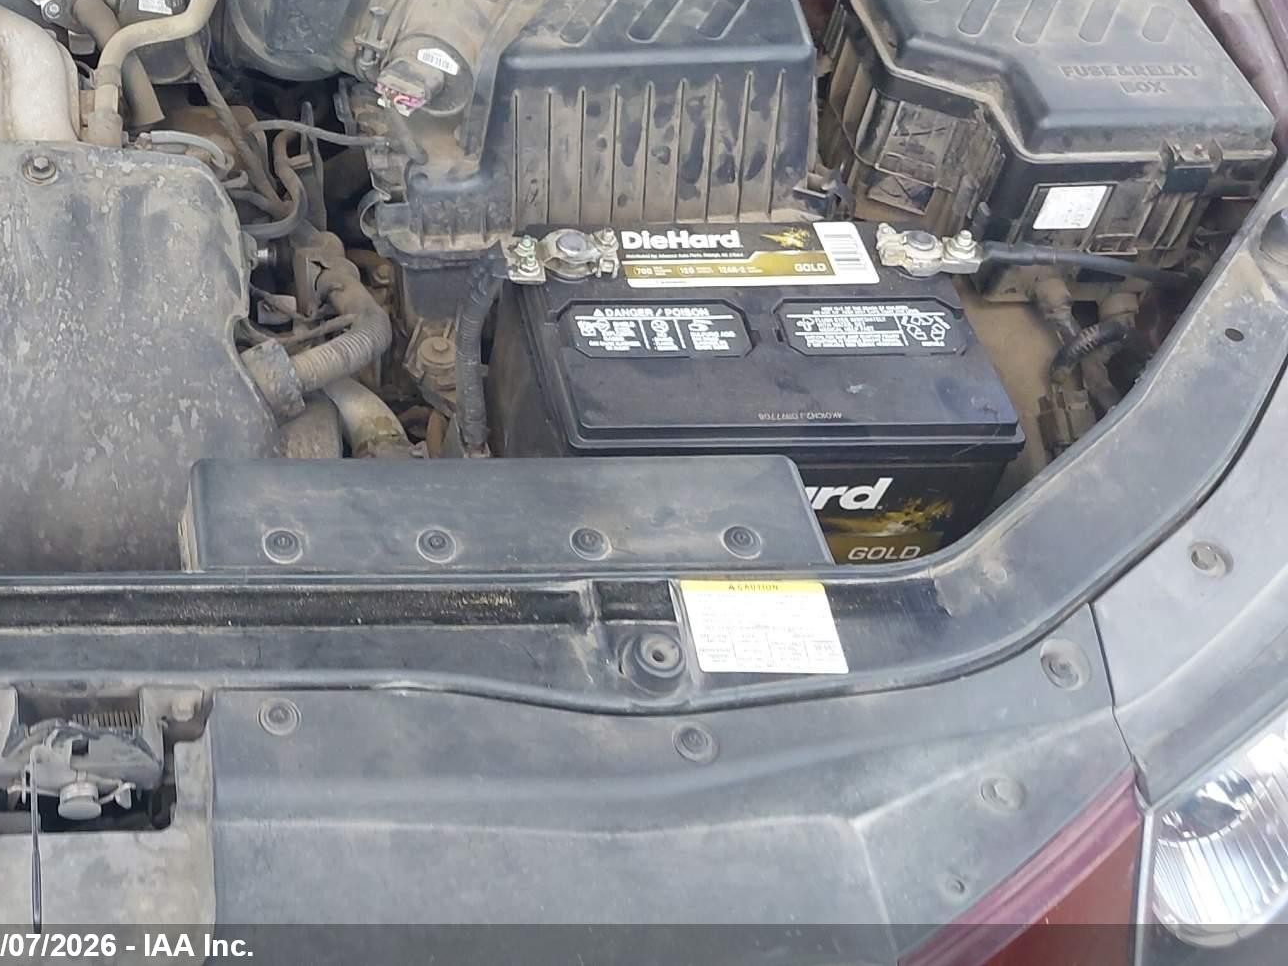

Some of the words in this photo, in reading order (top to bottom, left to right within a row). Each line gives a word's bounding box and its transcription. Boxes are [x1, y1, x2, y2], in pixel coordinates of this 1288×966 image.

[620, 229, 740, 250] DieHard
[635, 267, 653, 275] 700
[794, 263, 826, 272] GOLD
[605, 308, 654, 317] DANGER
[665, 307, 710, 317] POISON
[847, 545, 921, 560] GOLD
